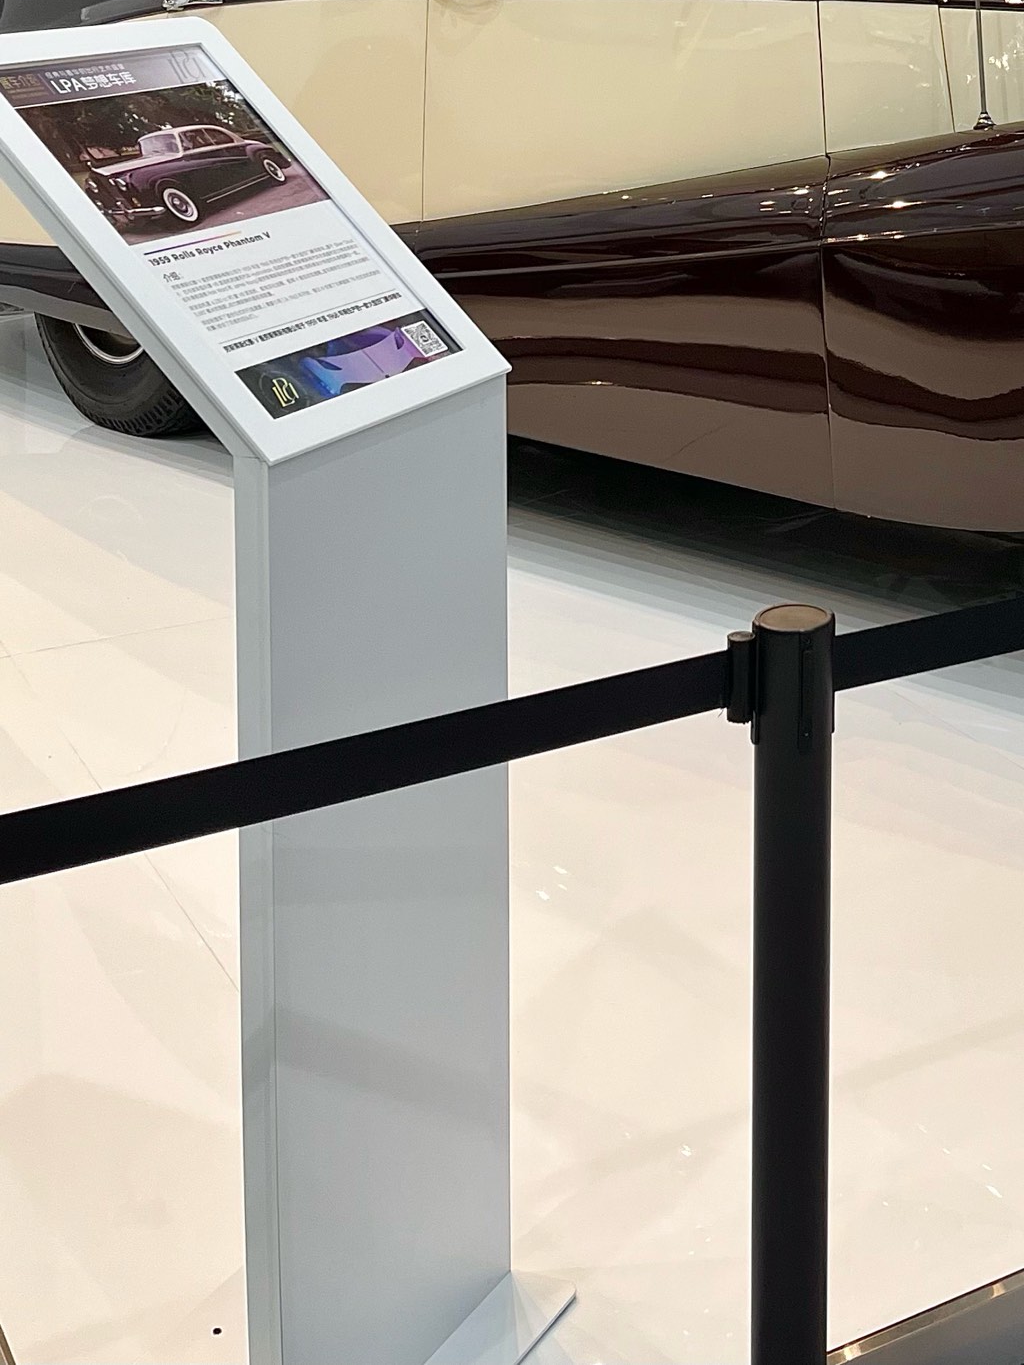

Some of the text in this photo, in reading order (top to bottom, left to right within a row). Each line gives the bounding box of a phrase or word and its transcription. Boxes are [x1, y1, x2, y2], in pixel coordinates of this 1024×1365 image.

[50, 71, 137, 94] LPA梦想车库
[148, 231, 271, 267] 1959 Rolls Royce Phantom V
